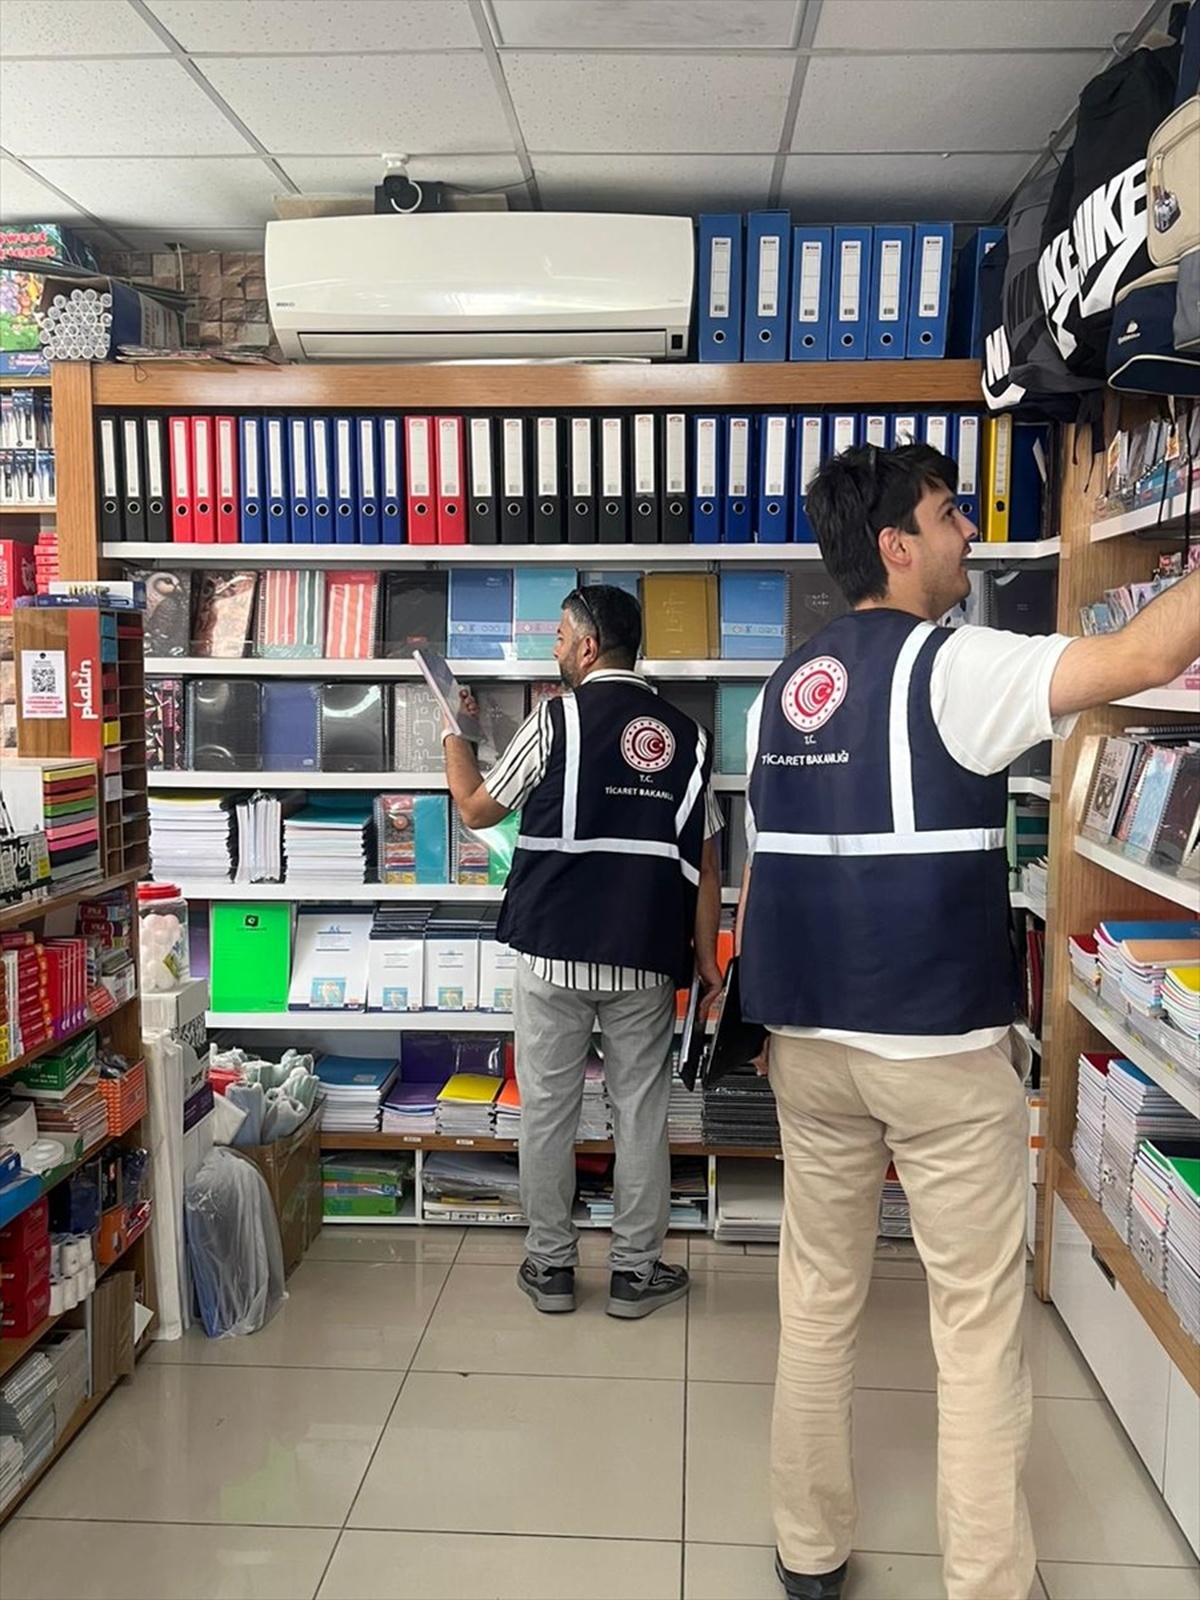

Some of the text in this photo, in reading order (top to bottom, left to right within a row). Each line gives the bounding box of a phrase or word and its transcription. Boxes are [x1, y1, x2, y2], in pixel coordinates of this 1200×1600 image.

[72, 659, 99, 719] platin
[761, 749, 850, 766] TİCARET BAKANLIĞI
[605, 785, 638, 796] TİCARET
